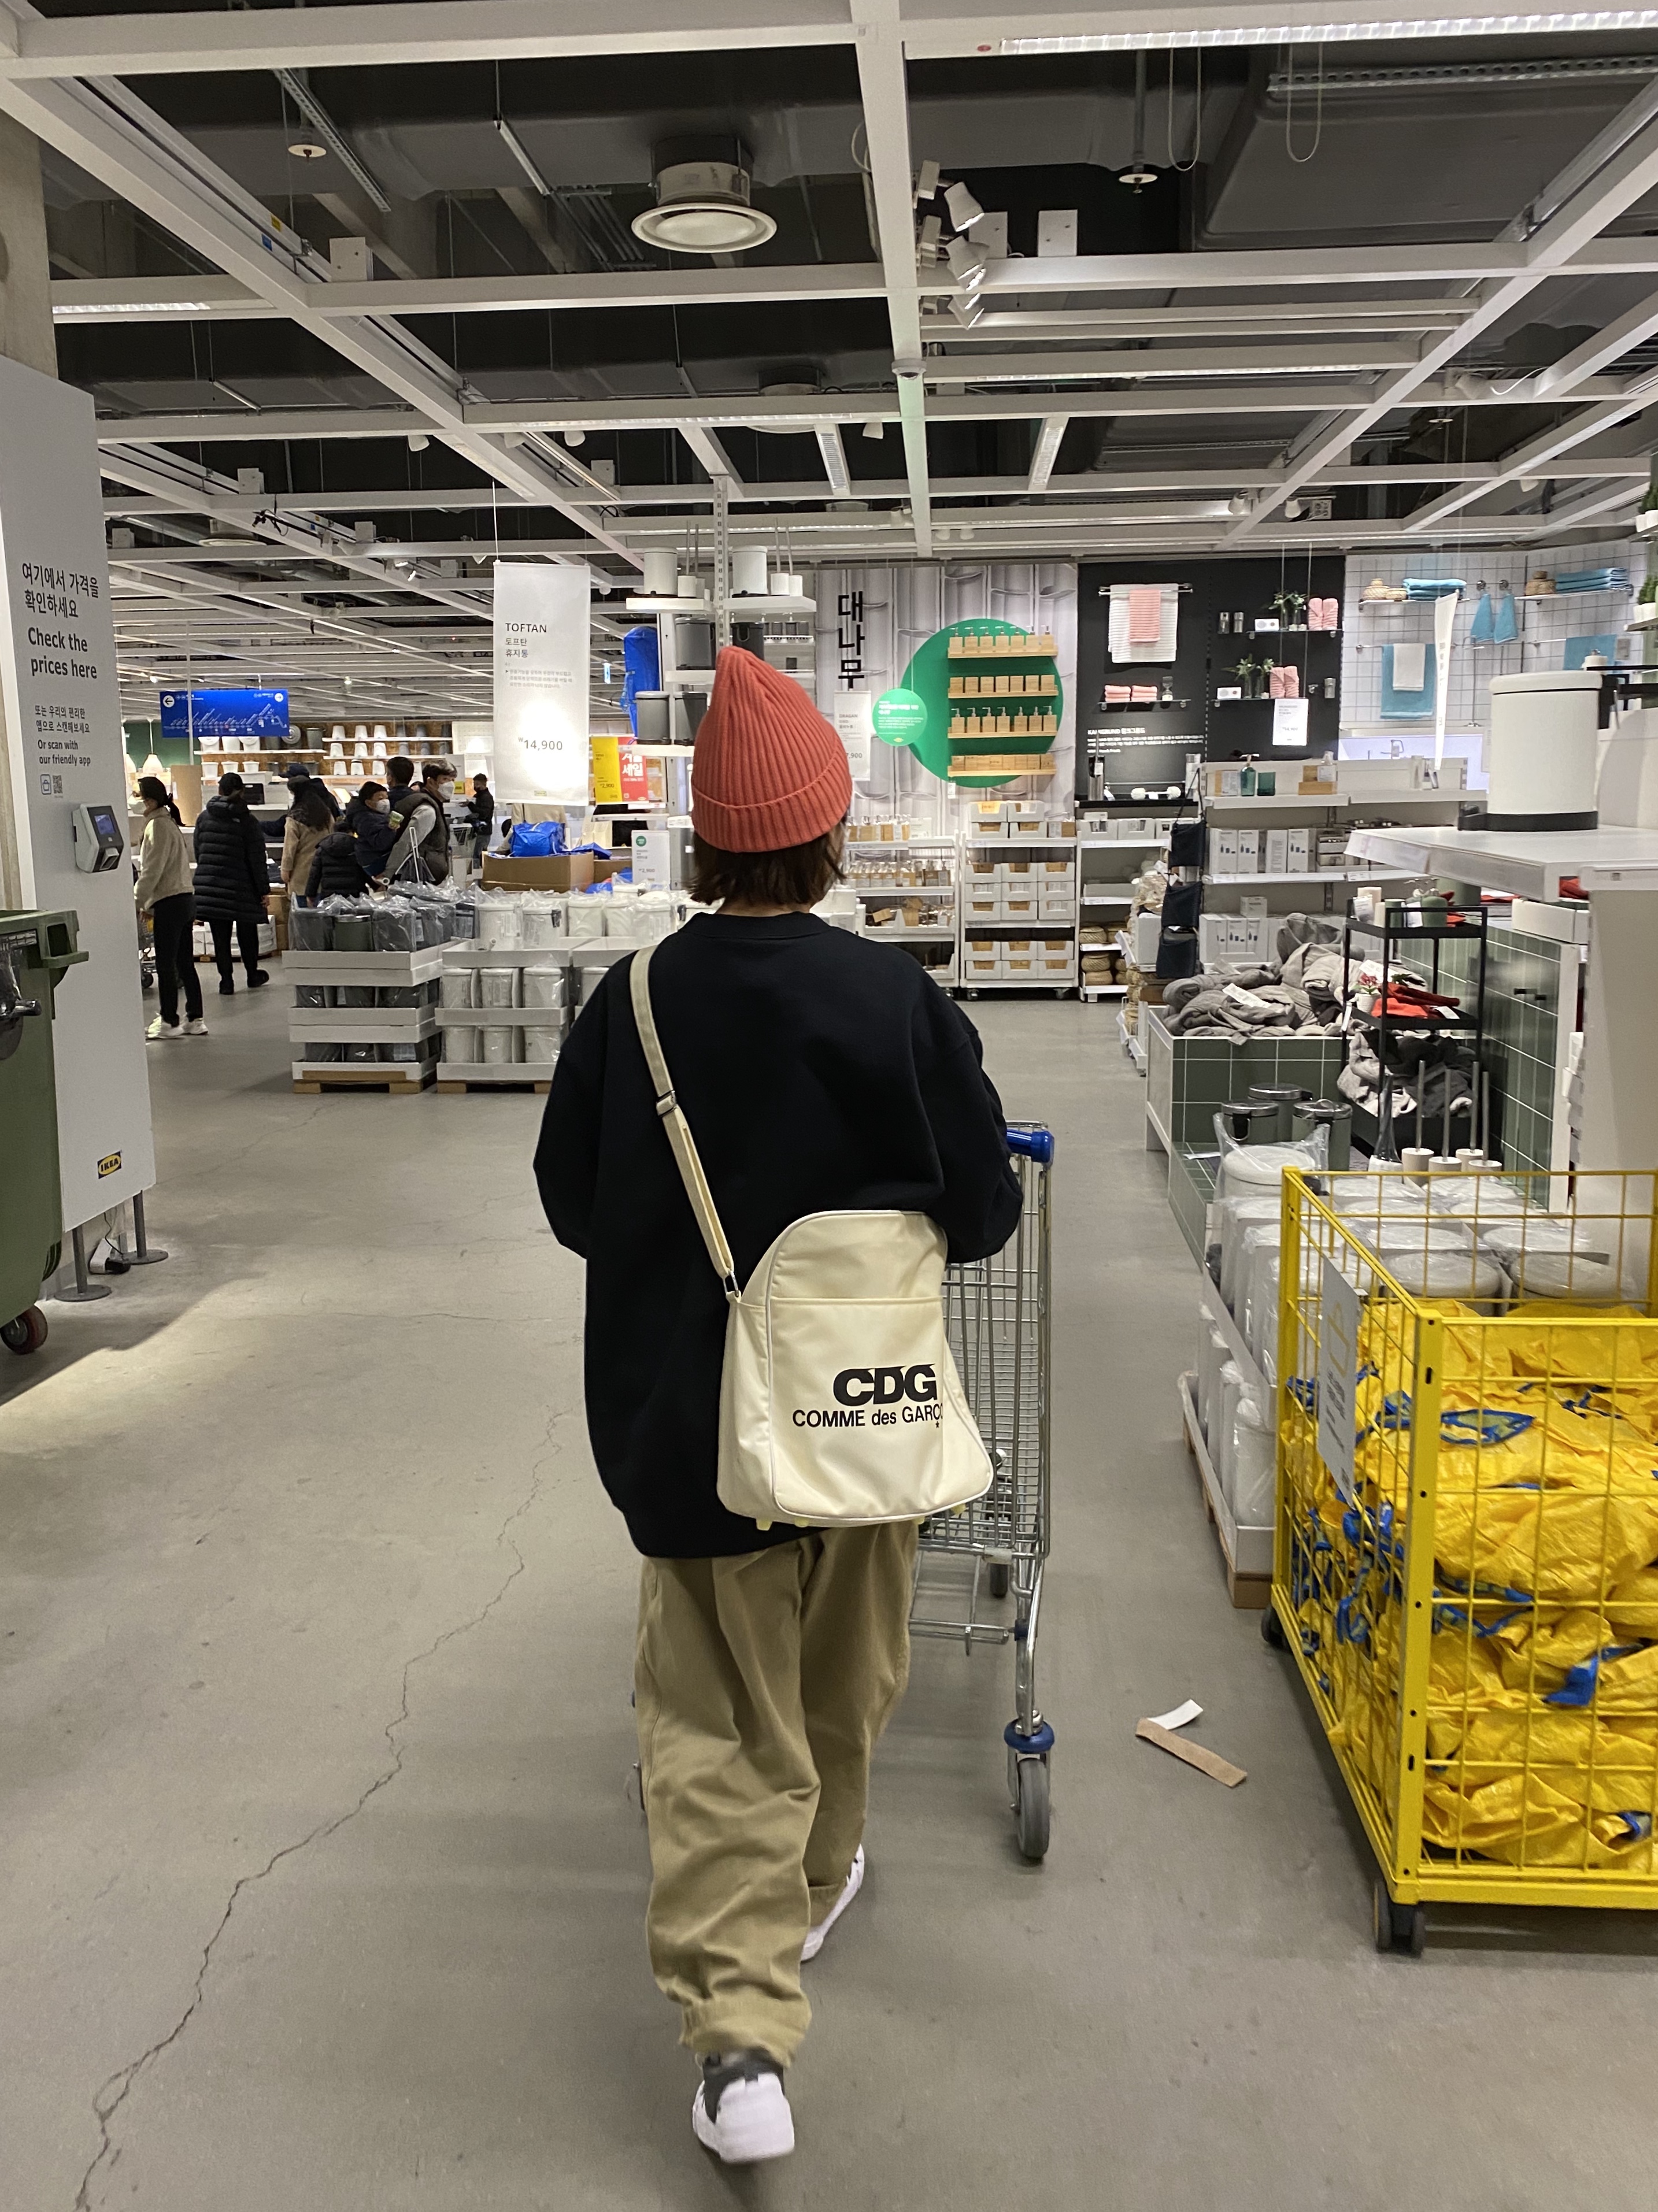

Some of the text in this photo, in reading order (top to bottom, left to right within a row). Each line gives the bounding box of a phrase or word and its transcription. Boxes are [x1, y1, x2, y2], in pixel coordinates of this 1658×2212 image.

[22, 562, 98, 598] 여기에서 가격을
[24, 589, 79, 618] 확인하세요
[505, 623, 547, 633] TOFTAN
[28, 627, 88, 652] Check the
[505, 638, 527, 646] 토프탄
[838, 591, 865, 688] 대나무
[505, 649, 528, 658] 휴지통
[31, 655, 97, 679] prices here
[35, 705, 86, 719] 또는 우리의 편리한
[36, 720, 54, 732] 앱으로
[38, 739, 79, 750] Or scan with
[39, 754, 91, 766] our friendly app
[621, 763, 643, 776] 세일
[101, 1158, 119, 1172] IKEA
[833, 1363, 938, 1406] CDG
[793, 1409, 865, 1428] COMME
[871, 1409, 897, 1426] des
